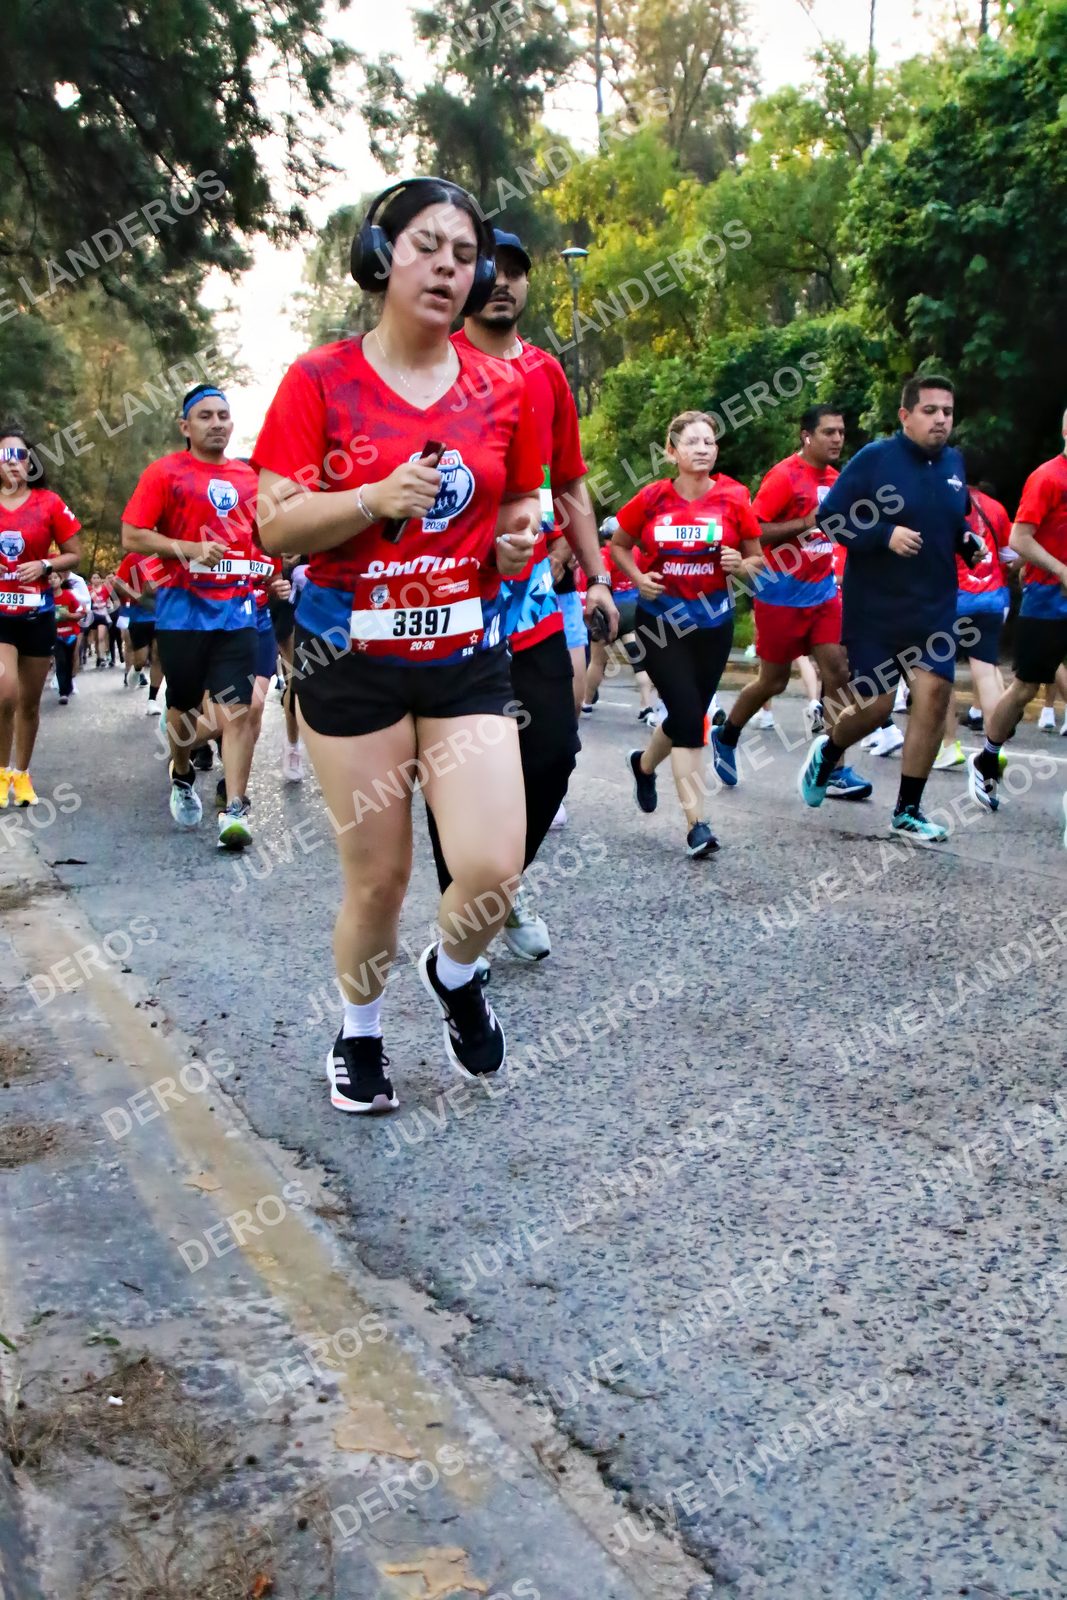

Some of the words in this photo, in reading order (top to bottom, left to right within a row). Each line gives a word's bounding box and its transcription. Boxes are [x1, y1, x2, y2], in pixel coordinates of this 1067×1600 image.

[675, 526, 701, 540] 1873
[662, 561, 714, 576] SANTIAGO
[392, 607, 451, 637] 3397
